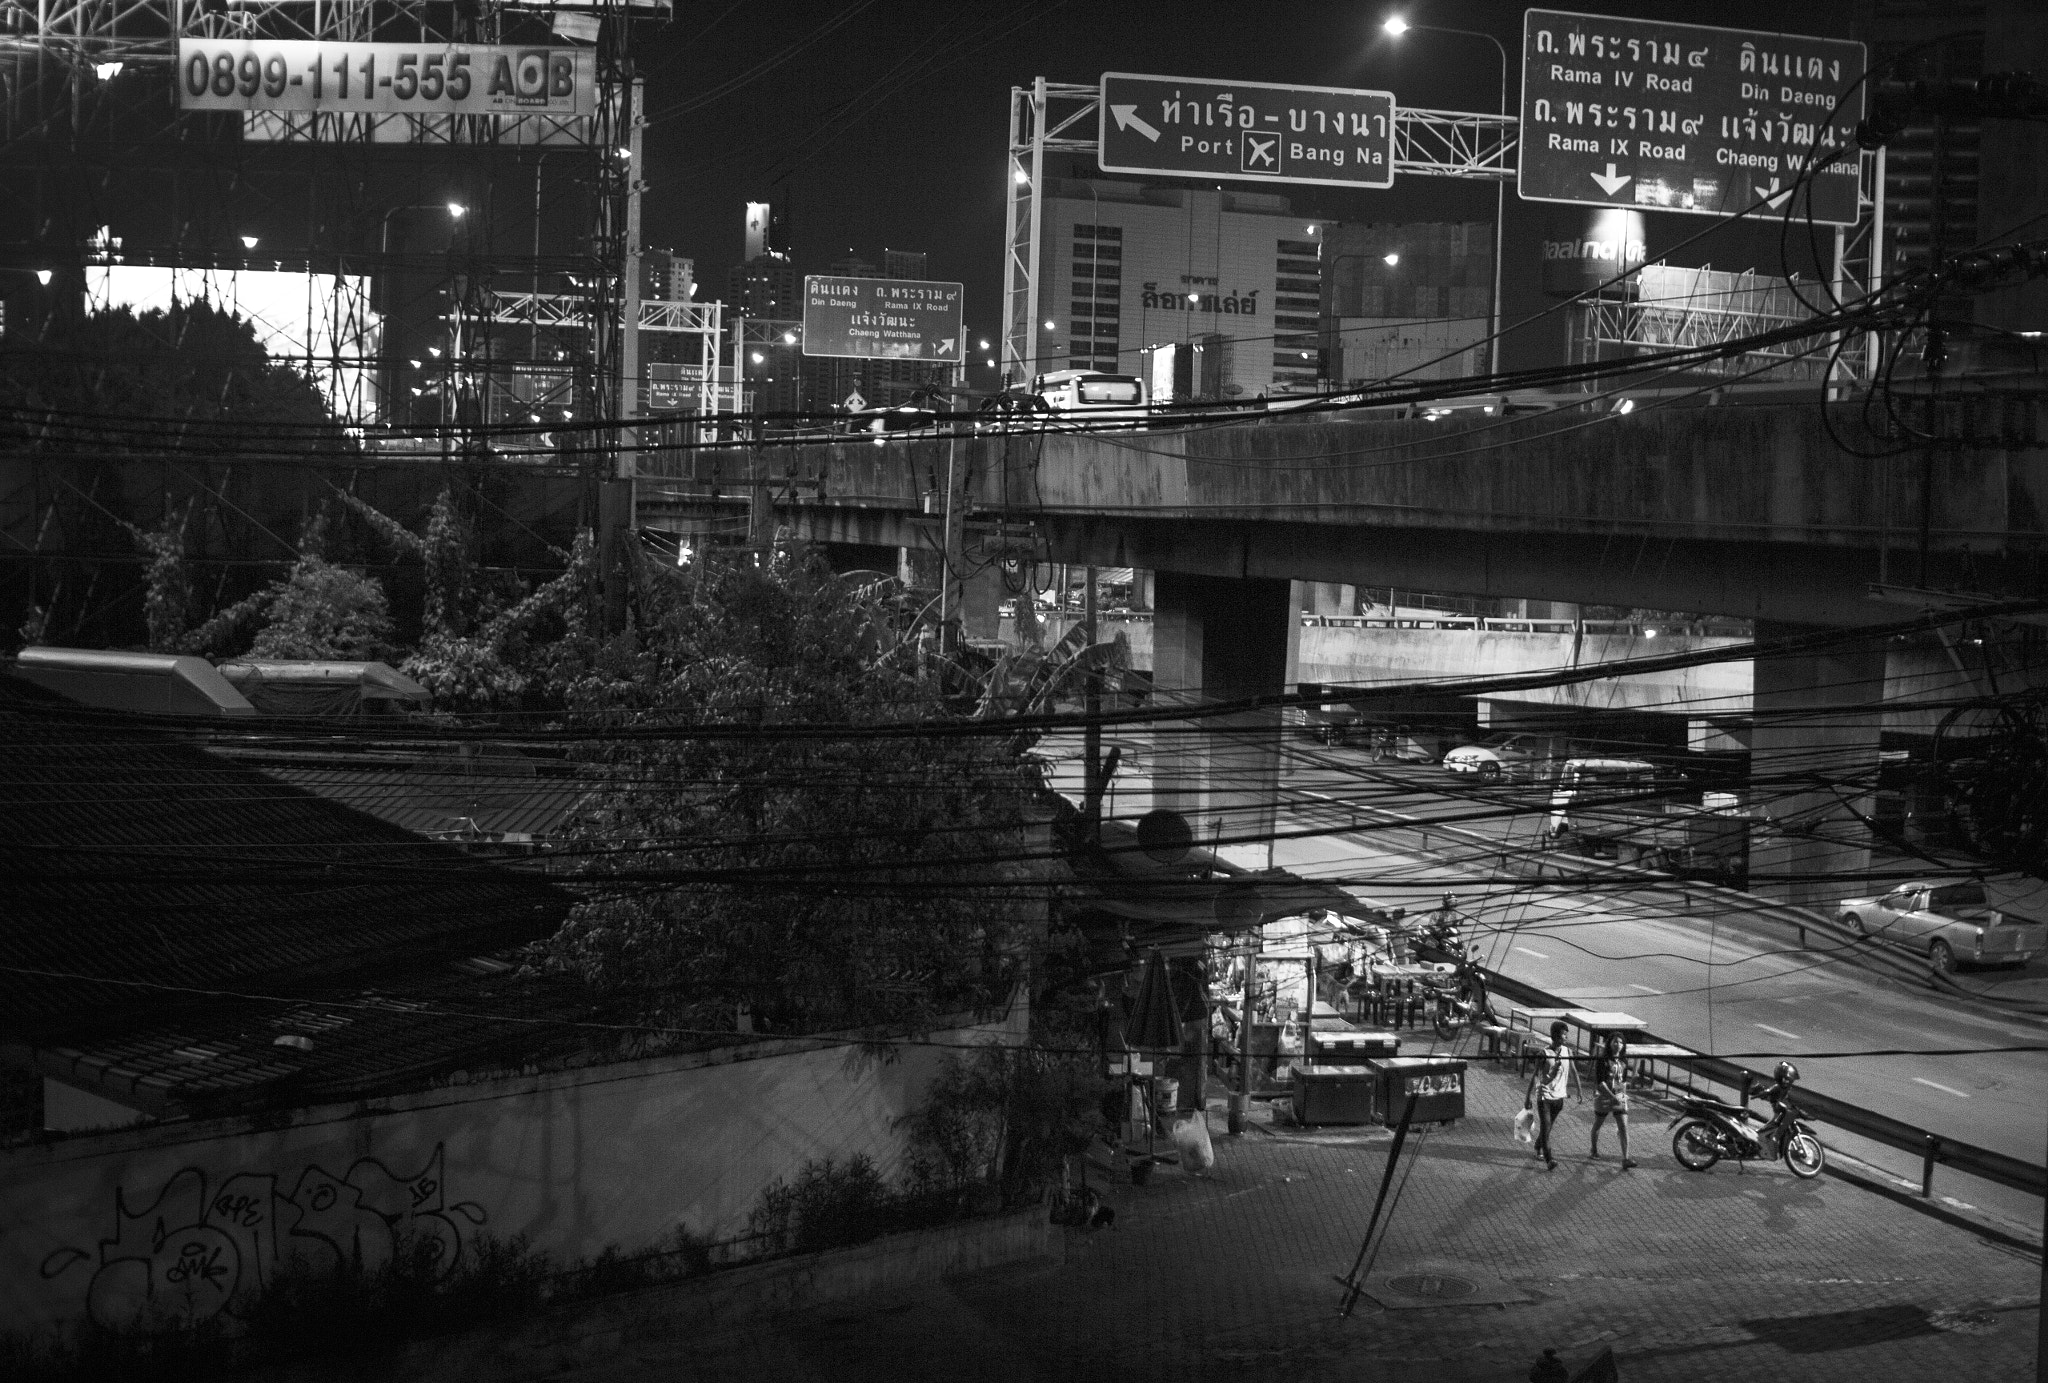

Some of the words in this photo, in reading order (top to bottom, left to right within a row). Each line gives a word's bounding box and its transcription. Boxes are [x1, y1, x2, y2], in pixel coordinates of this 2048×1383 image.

[185, 49, 472, 101] 0899-111-555
[487, 54, 573, 97] AOB
[1551, 64, 1602, 85] Rama
[1614, 70, 1634, 87] IV
[1646, 73, 1693, 93] Road
[1741, 82, 1769, 101] Din
[1781, 86, 1837, 111] Daeng
[1181, 135, 1233, 155] Port
[1290, 142, 1345, 166] Bang
[1357, 147, 1383, 165] Na
[1548, 132, 1600, 153] Rama
[1610, 138, 1629, 156] IX
[1639, 141, 1686, 160] Road
[1716, 148, 1778, 173] Chaeng
[810, 280, 859, 296] ดินแดง
[811, 297, 826, 306] Din
[830, 298, 857, 309] Daeng
[885, 301, 909, 310] Rama
[913, 302, 922, 311] IX
[926, 302, 949, 312] Road
[849, 328, 880, 339] Chaeng
[883, 329, 921, 339] Watthana
